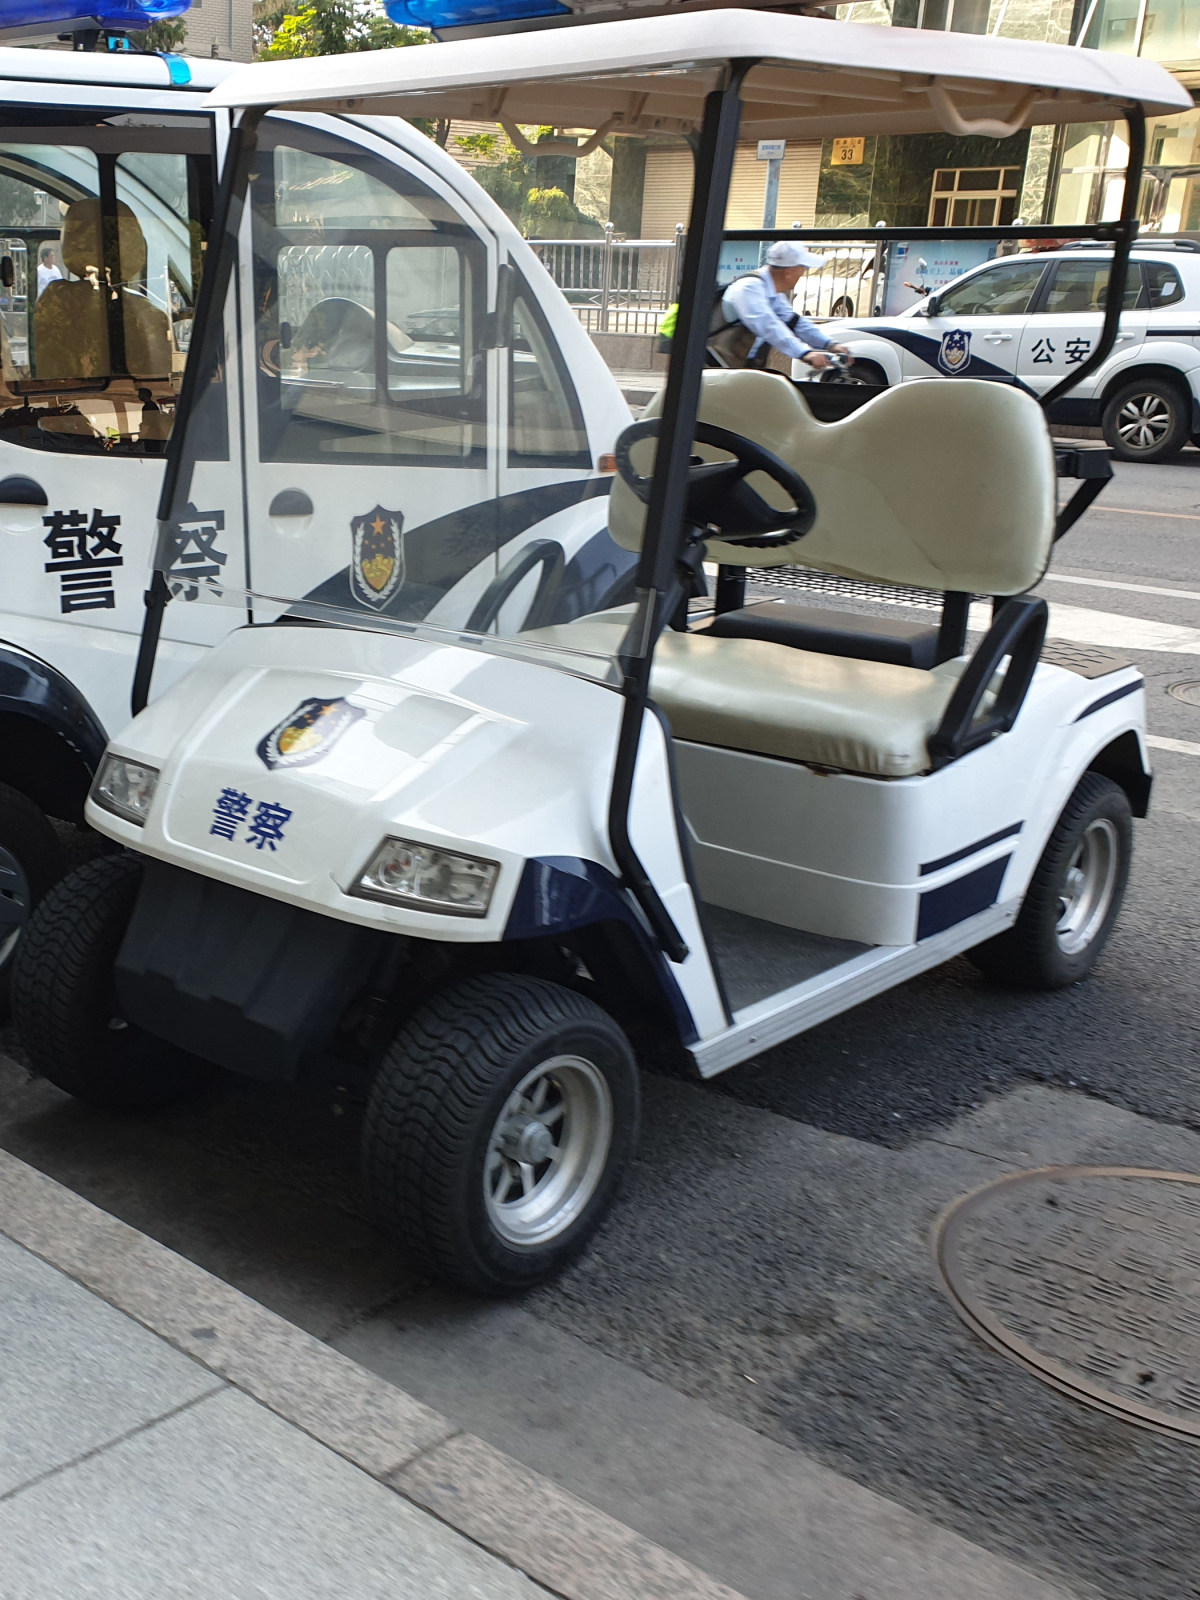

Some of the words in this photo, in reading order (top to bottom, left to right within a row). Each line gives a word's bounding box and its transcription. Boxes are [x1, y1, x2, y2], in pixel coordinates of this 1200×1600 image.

[841, 149, 854, 161] 33
[1031, 337, 1091, 364] 公安
[42, 501, 228, 614] 警察
[209, 787, 293, 852] 警察
